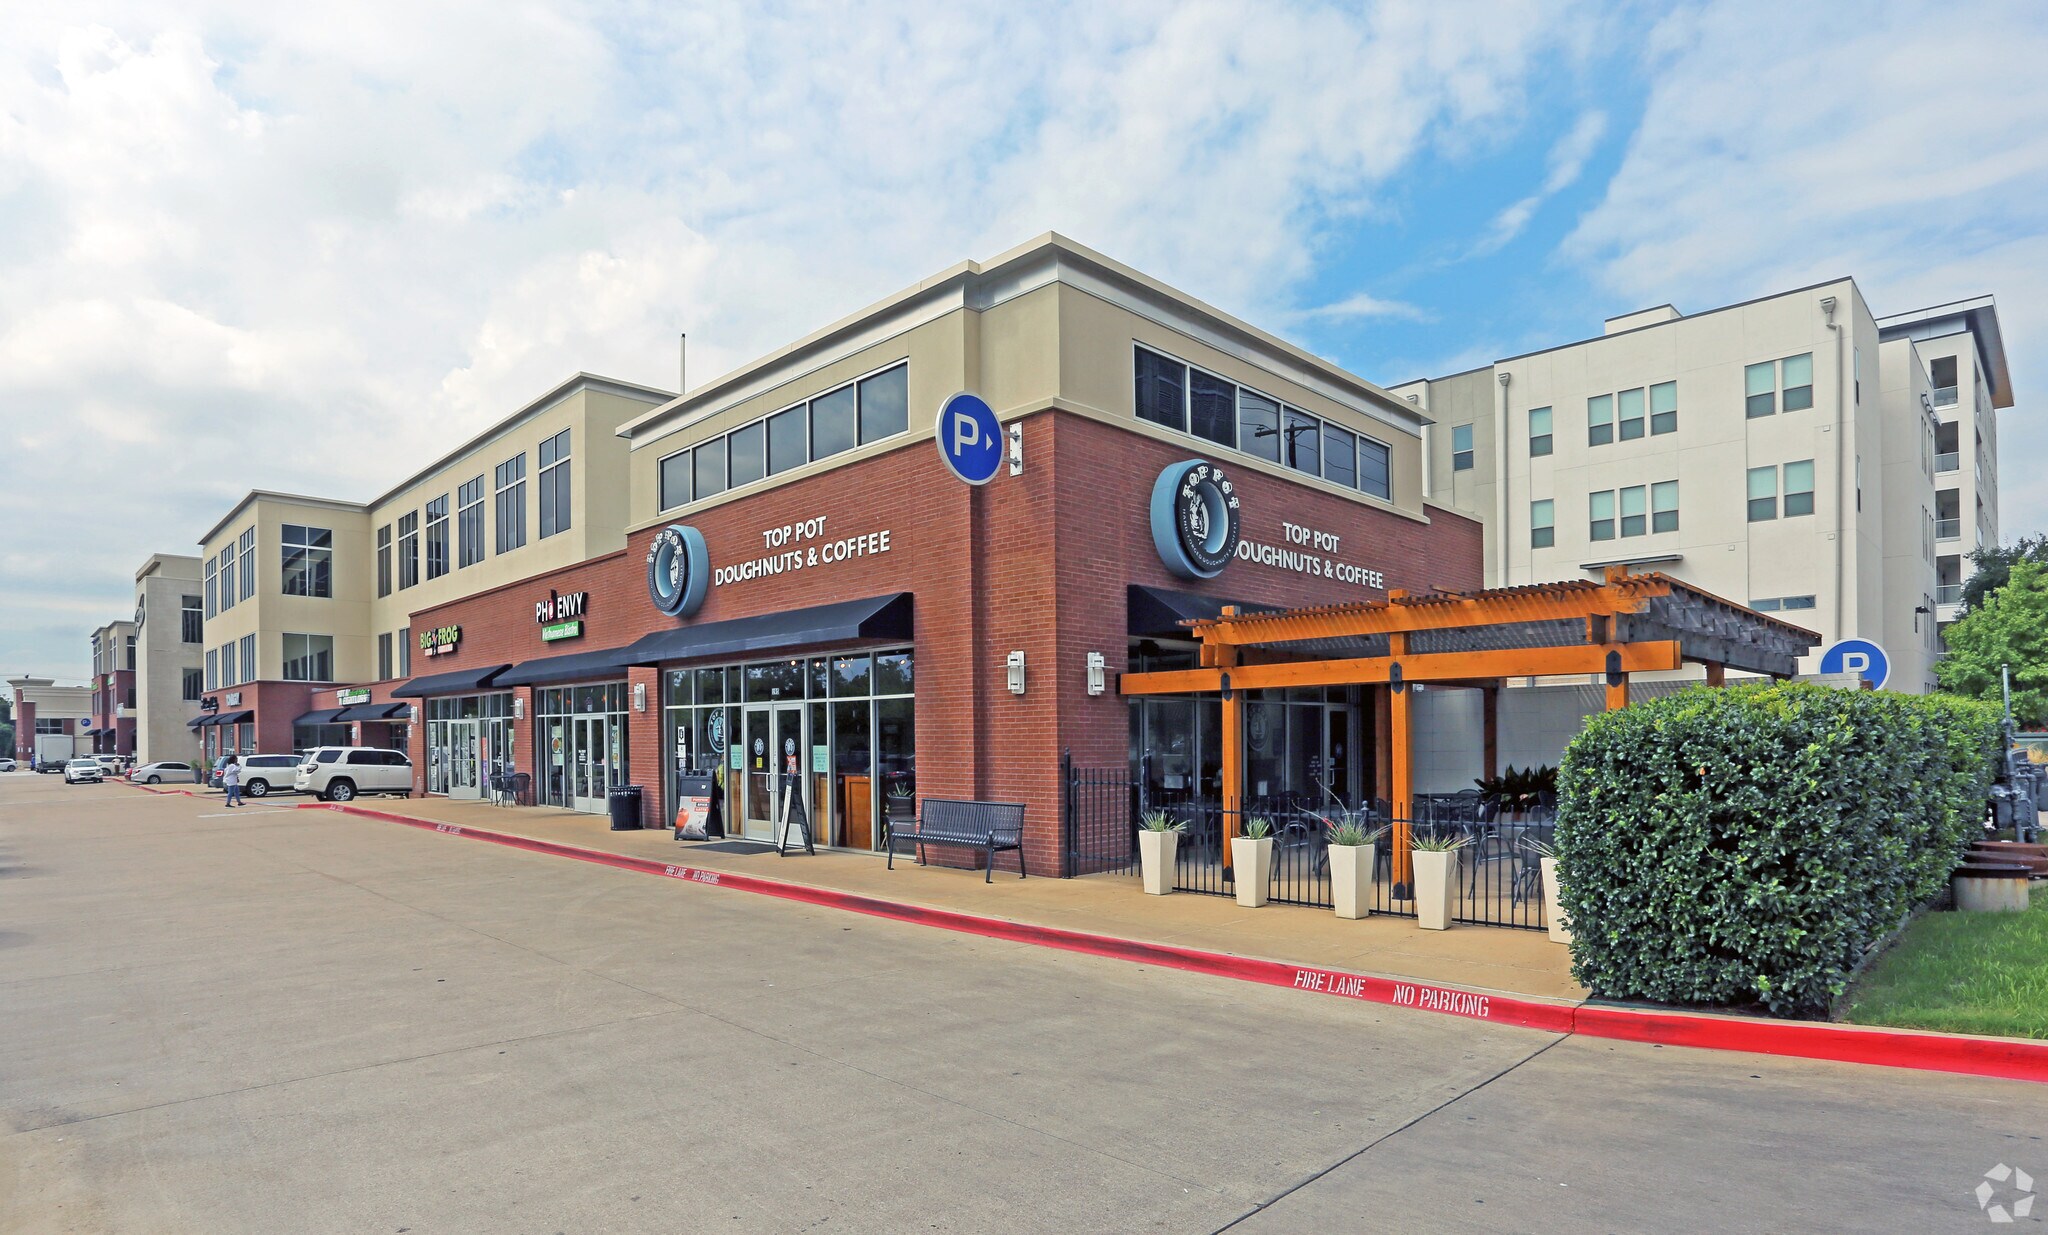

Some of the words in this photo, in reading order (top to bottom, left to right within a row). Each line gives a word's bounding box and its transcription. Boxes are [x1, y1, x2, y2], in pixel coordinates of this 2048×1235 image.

[954, 412, 979, 457] P
[1183, 466, 1208, 498] TOP
[1213, 468, 1240, 508] POT
[763, 525, 792, 549] TOP
[795, 516, 827, 542] POT
[1283, 522, 1311, 546] TOP
[1313, 530, 1340, 553] POT
[715, 550, 803, 586] DOUGHNUTS
[806, 547, 818, 567] &
[822, 530, 891, 564] COFFEE
[1233, 540, 1321, 576] OUGHNUTS
[1324, 559, 1334, 579] &
[1335, 563, 1384, 589] COFFEE
[557, 592, 583, 619] ENVY
[420, 631, 431, 649] BIG
[438, 625, 458, 645] FROG
[1842, 652, 1870, 674] P
[665, 865, 676, 876] FIRE
[673, 867, 687, 878] LANE
[699, 871, 720, 885] PARKING
[1294, 970, 1326, 991] FIRE
[1327, 974, 1366, 997] LANE
[1392, 984, 1415, 1004] NO
[1418, 988, 1489, 1017] PARKING
